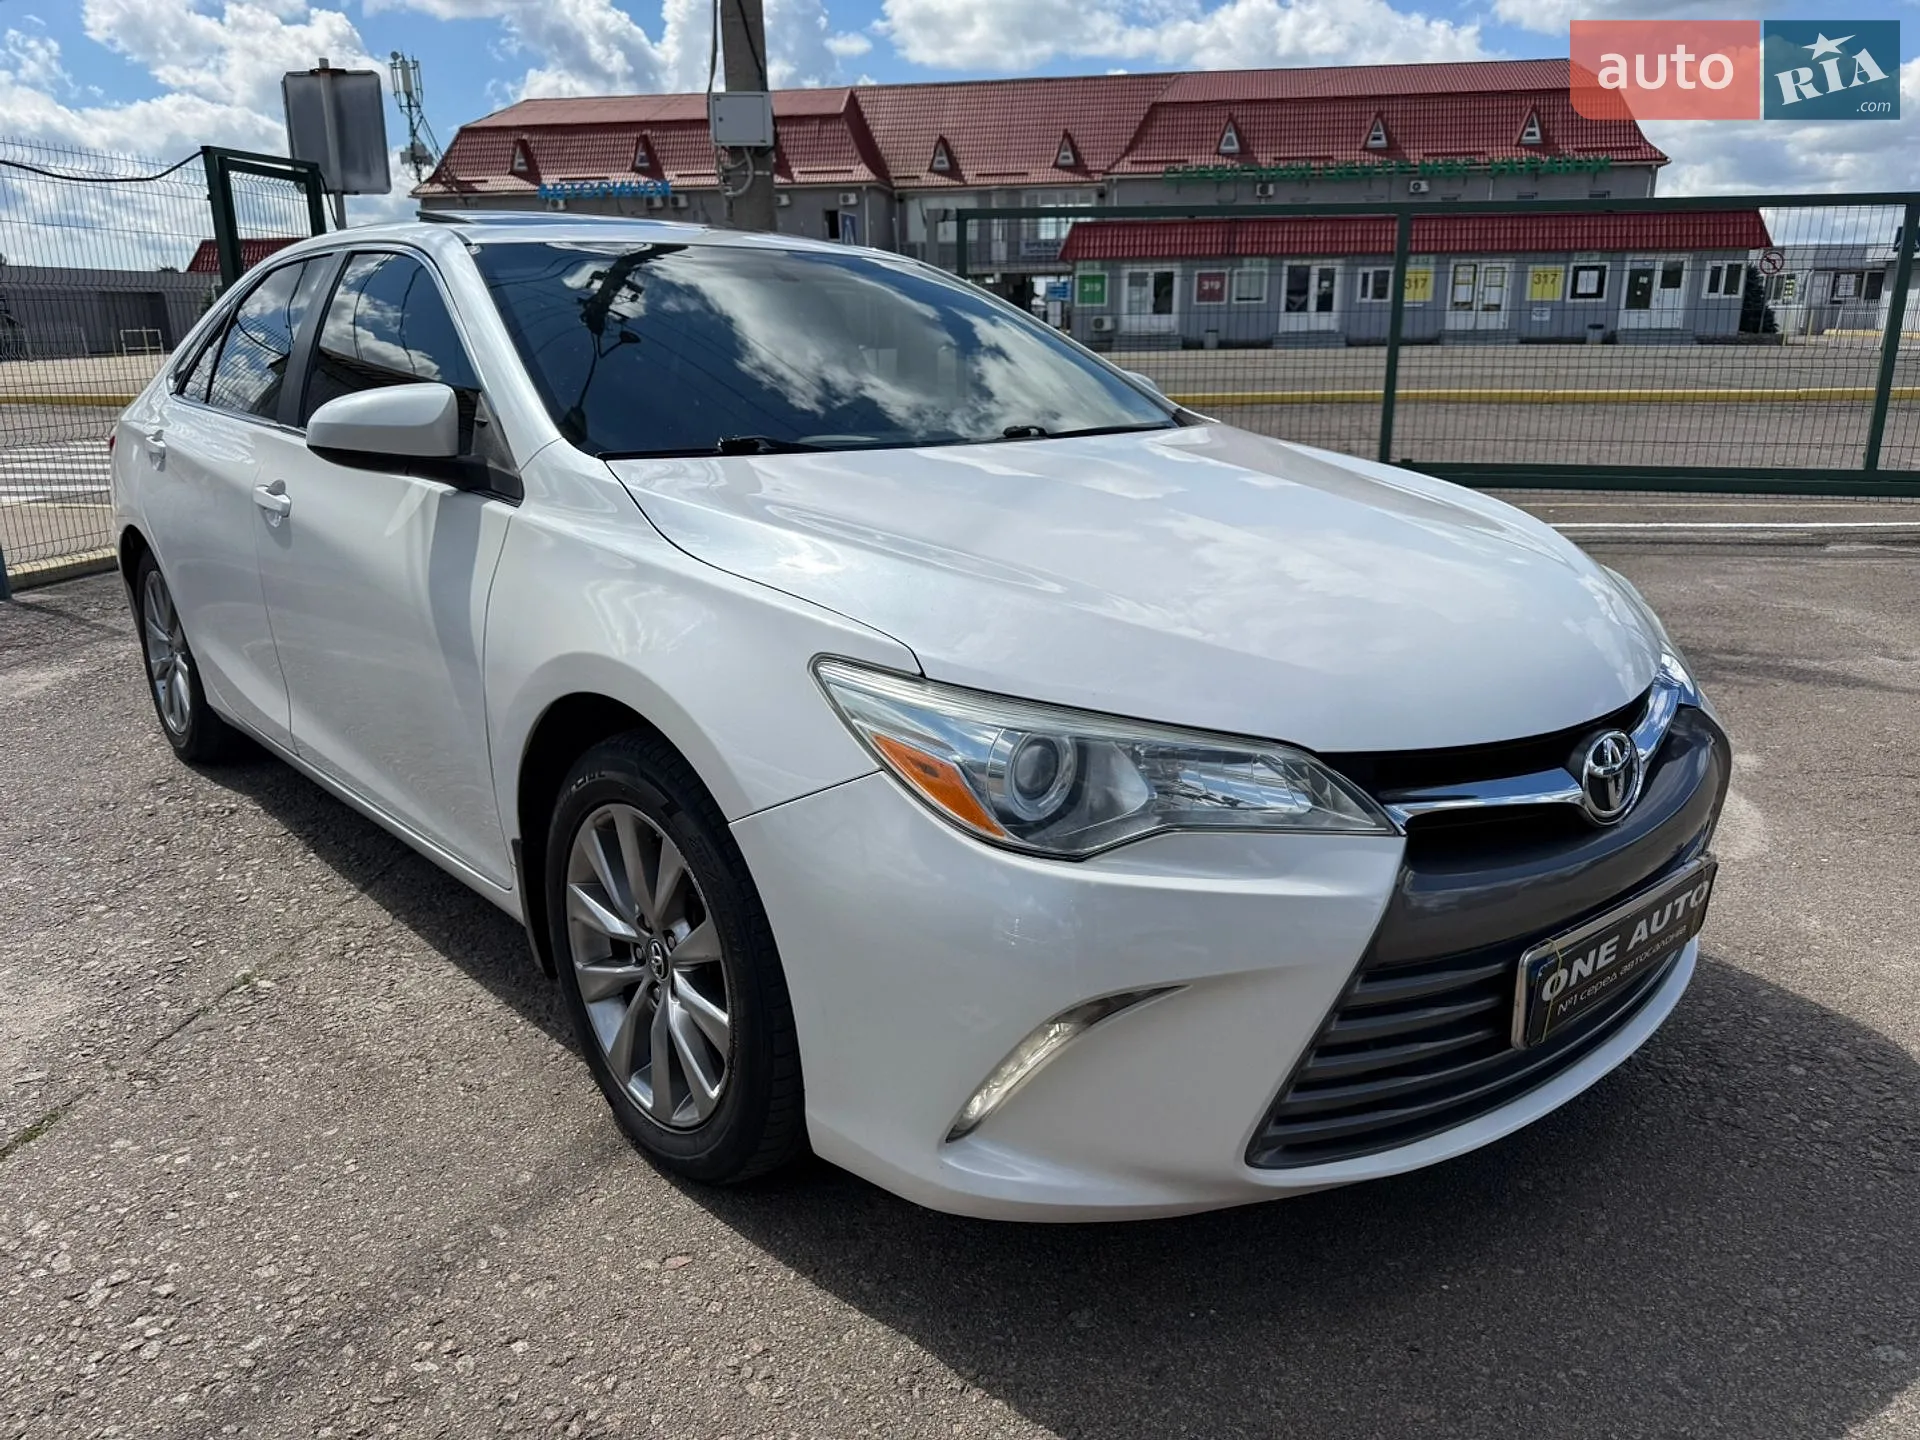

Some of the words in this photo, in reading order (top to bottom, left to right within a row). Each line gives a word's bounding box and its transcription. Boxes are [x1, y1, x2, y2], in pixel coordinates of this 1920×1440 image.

[1404, 277, 1428, 290] 317
[1533, 273, 1559, 286] 317
[1542, 934, 1620, 1002] ONE
[1626, 880, 1710, 952] AUTO
